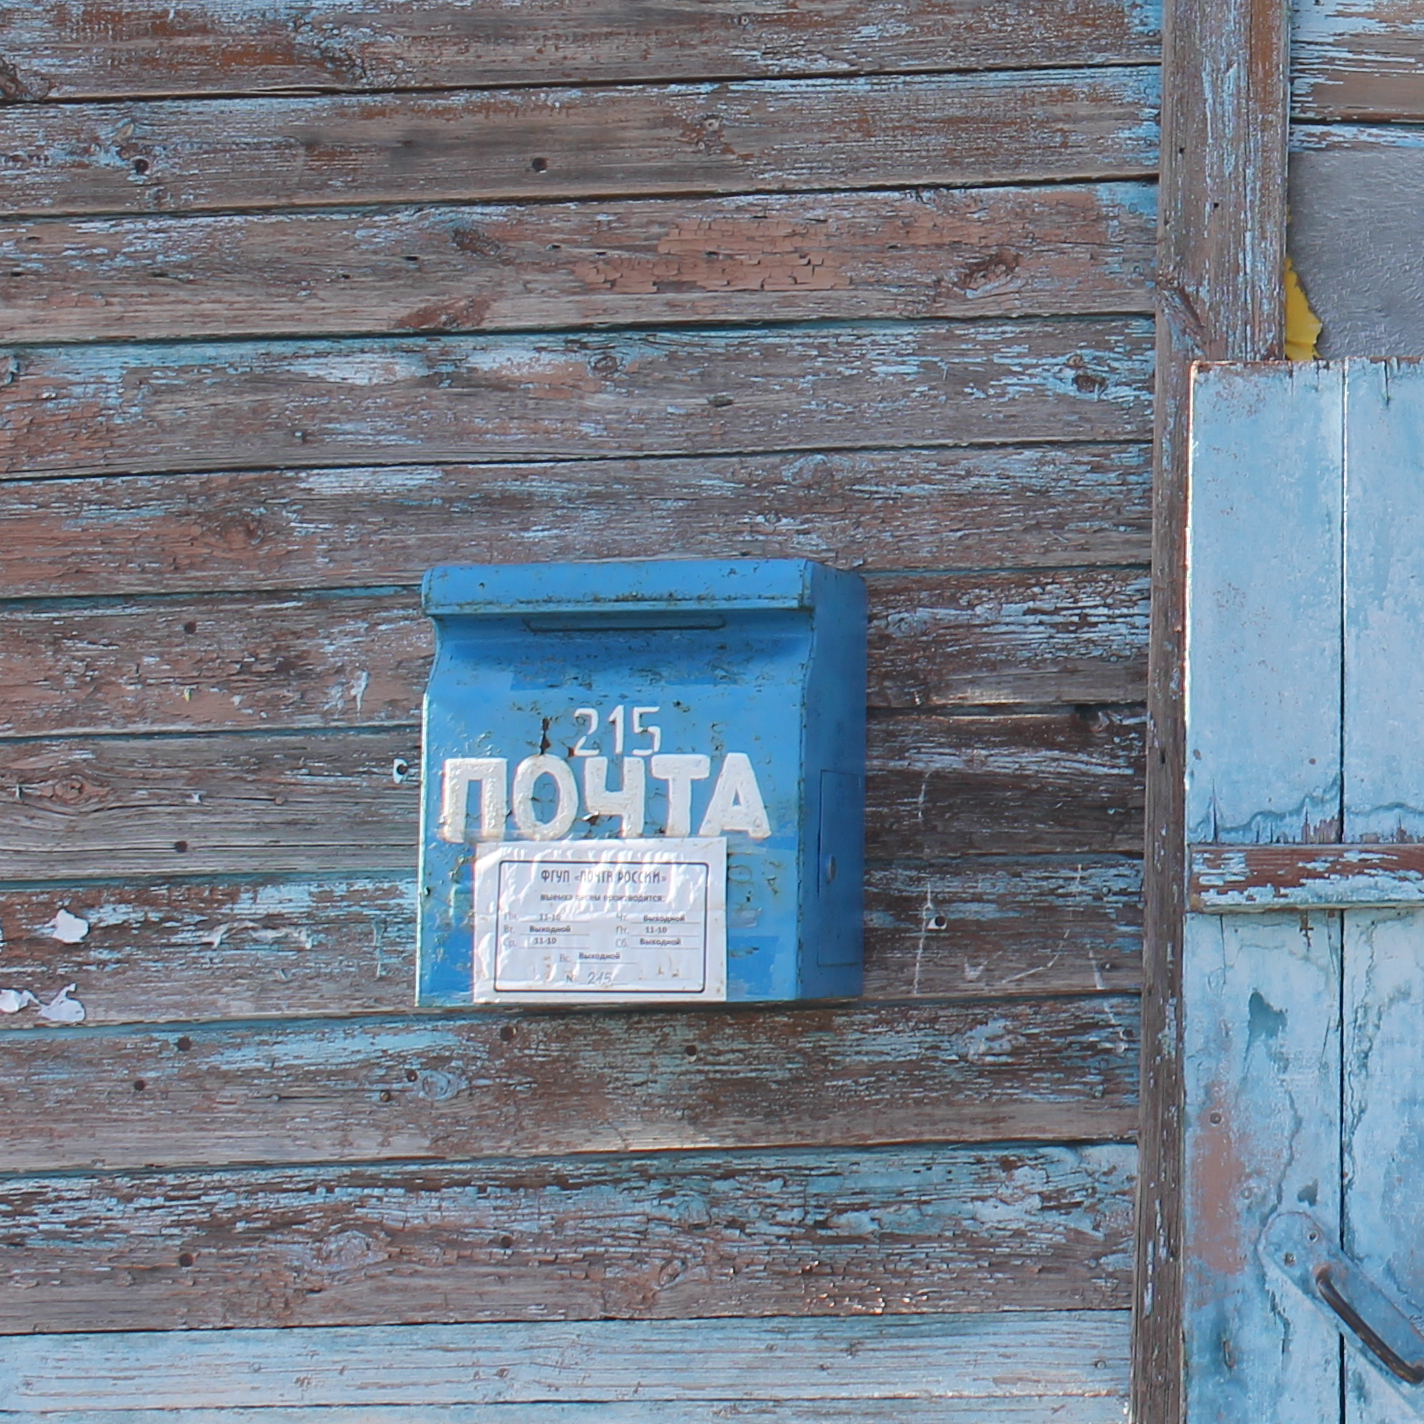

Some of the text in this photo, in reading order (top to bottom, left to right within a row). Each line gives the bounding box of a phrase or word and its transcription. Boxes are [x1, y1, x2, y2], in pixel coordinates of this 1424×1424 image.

[573, 705, 661, 756] 215
[443, 753, 771, 843] ПОЧТА
[541, 870, 570, 884] ФГУП
